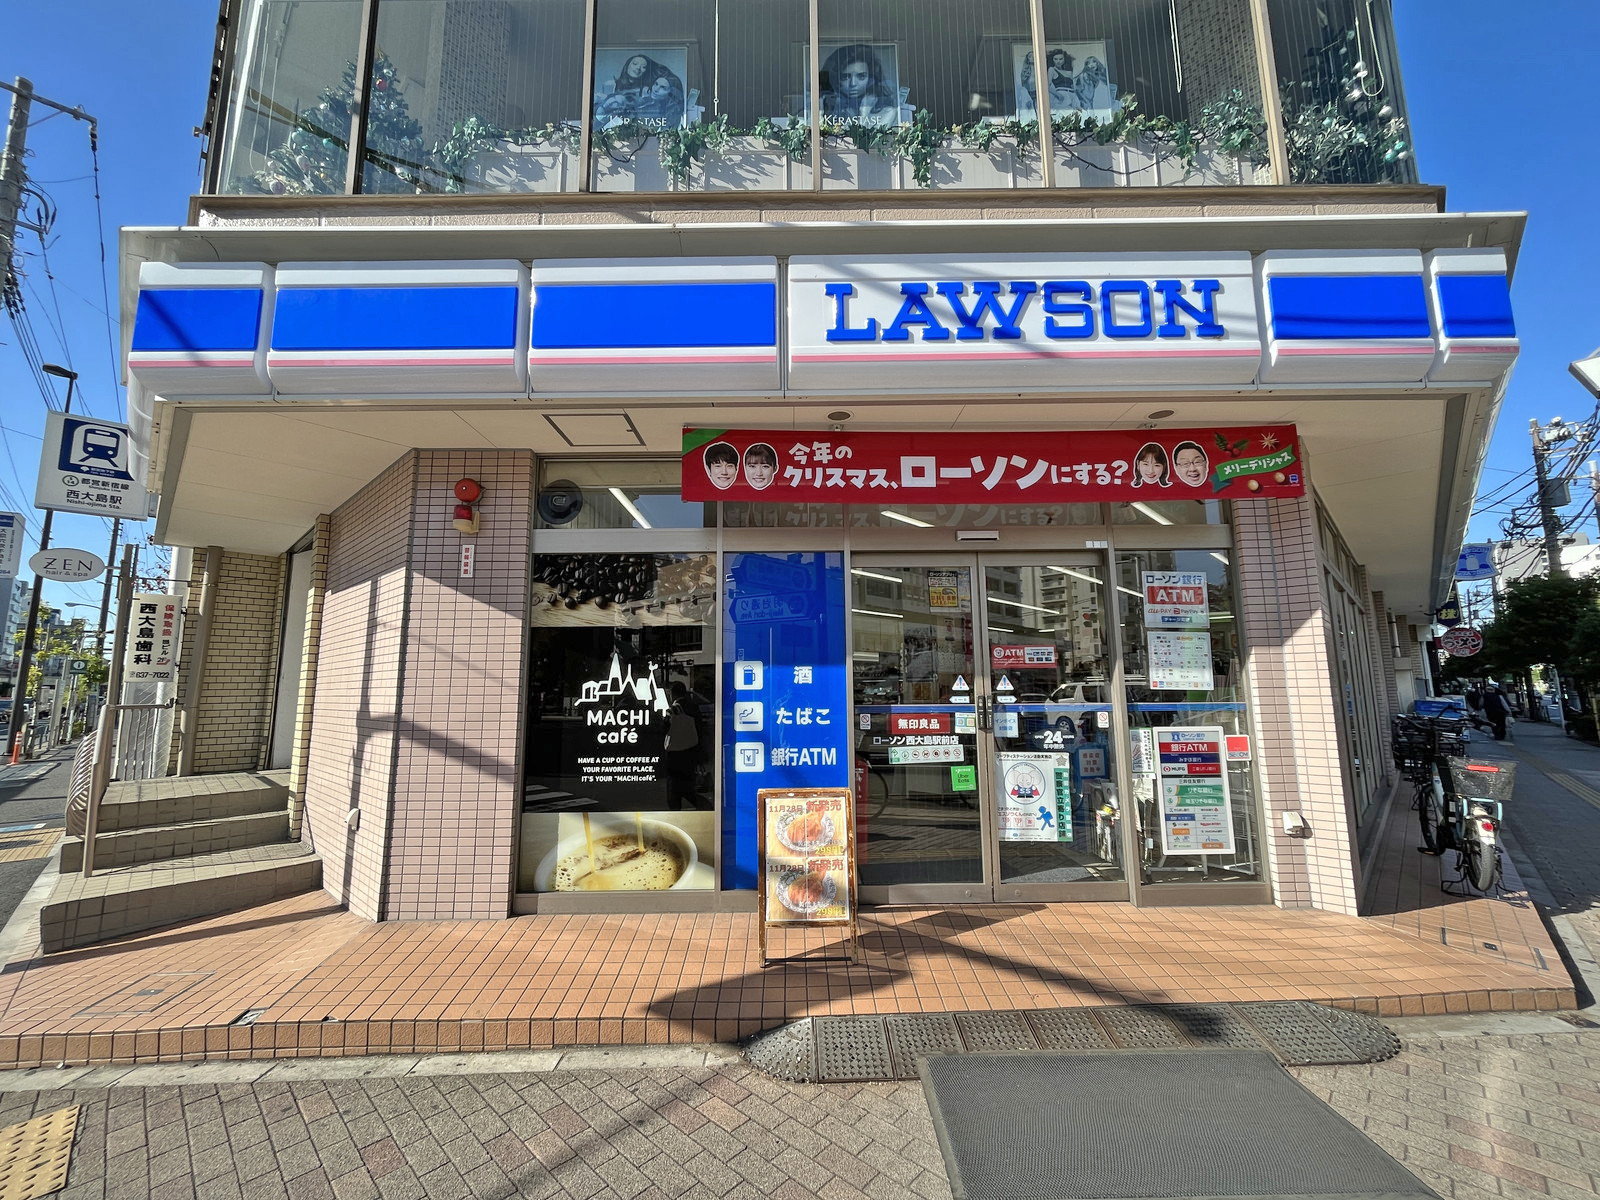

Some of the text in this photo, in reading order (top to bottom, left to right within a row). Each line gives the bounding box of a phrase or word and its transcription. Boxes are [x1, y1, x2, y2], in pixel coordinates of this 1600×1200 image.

[825, 280, 1225, 341] LAWSON
[788, 441, 853, 465] 今年の
[1223, 452, 1292, 475] メリーデリシャス
[81, 478, 130, 490] 都営新宿線
[66, 489, 123, 504] 西大島駅
[66, 499, 107, 508] Nishi-ojima
[43, 557, 93, 571] ZEN
[1146, 575, 1203, 584] ローソン銀行
[1156, 589, 1195, 602] ATM
[134, 603, 158, 665] 西大島歯科
[793, 666, 813, 684] 酒
[587, 710, 650, 726] MACHI
[776, 707, 831, 725] たばこ
[898, 718, 940, 729] 無印良品
[597, 728, 639, 744] café
[873, 736, 959, 745] ローソン西大島駅前店
[1043, 731, 1063, 743] 24
[1171, 744, 1208, 752] 銀行ATM
[771, 747, 837, 766] 銀行ATM
[769, 800, 842, 813] 11月28日 新発売
[769, 859, 844, 873] 11月28日 新発売
